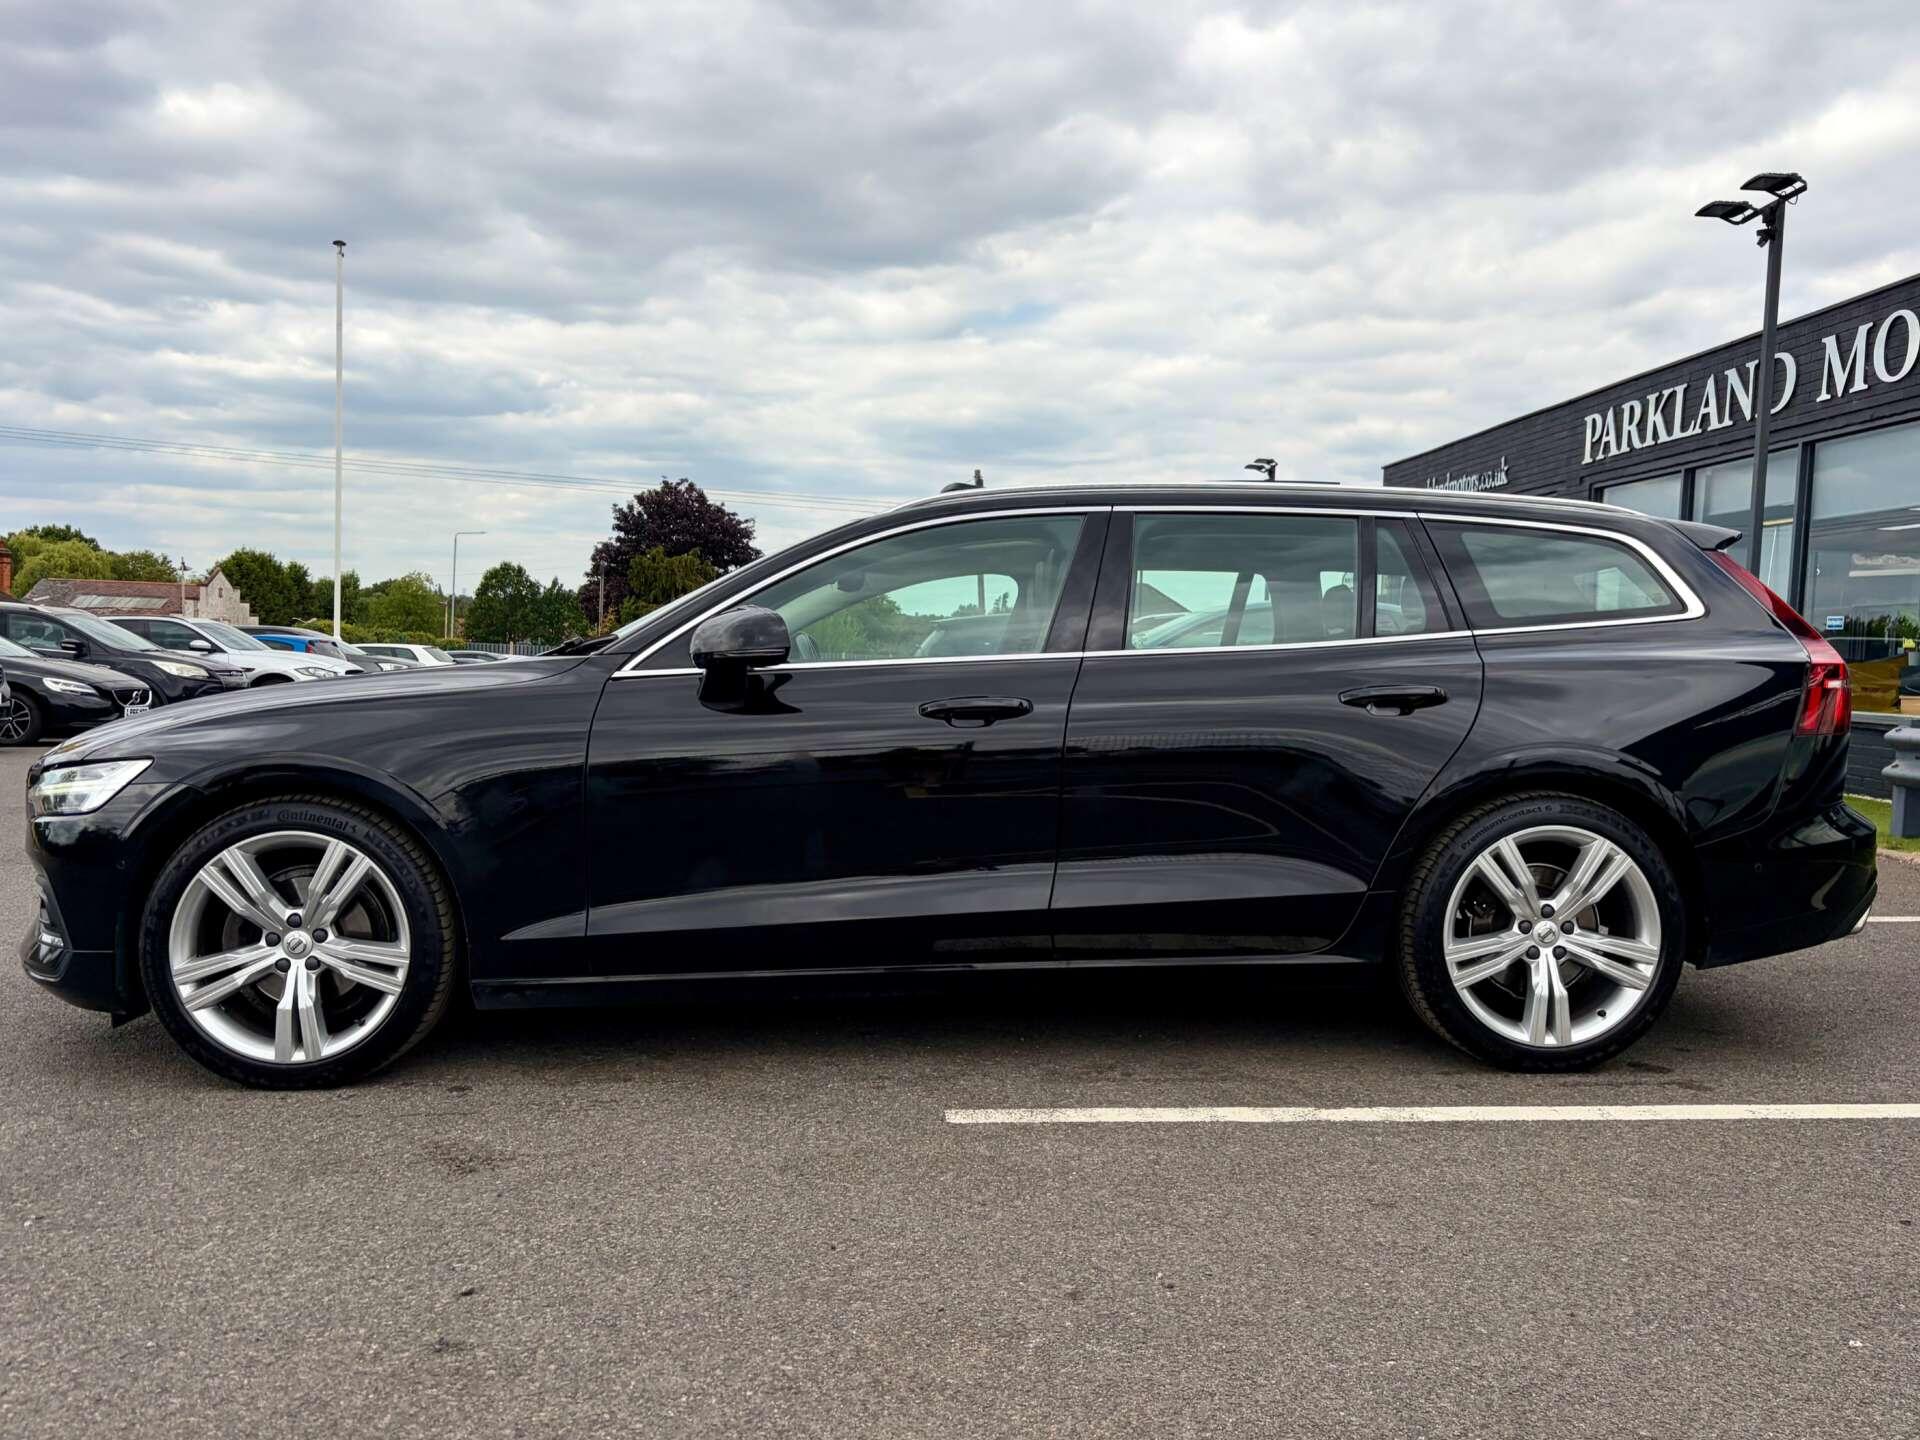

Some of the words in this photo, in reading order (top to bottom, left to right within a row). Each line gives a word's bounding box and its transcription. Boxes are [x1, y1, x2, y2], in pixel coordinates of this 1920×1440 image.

[1582, 352, 1797, 465] PARKLAND
[1816, 309, 1920, 402] MO
[277, 808, 350, 832] Continental
